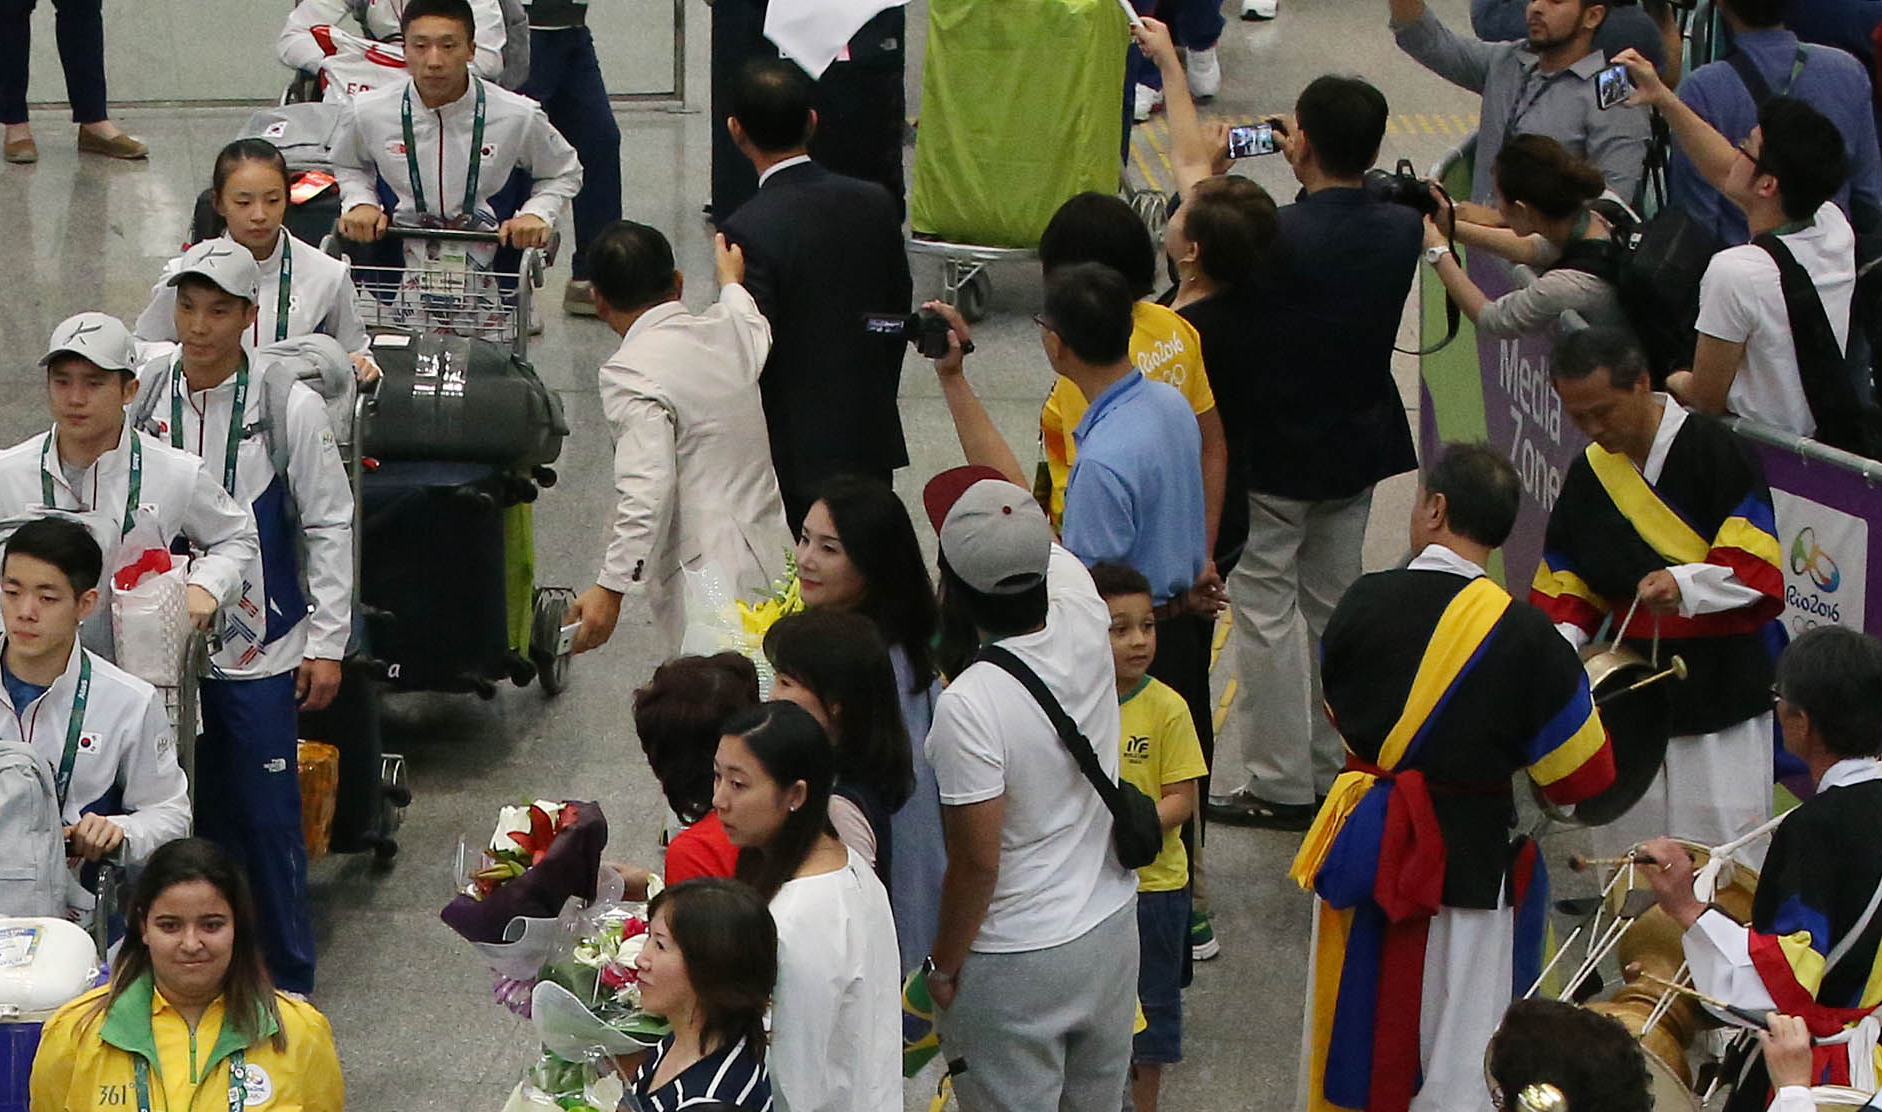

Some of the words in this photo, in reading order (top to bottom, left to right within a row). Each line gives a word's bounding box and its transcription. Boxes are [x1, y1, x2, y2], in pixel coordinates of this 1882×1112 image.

[1499, 339, 1562, 446] Media
[1509, 405, 1560, 513] Zone
[1786, 585, 1841, 622] Rio2016
